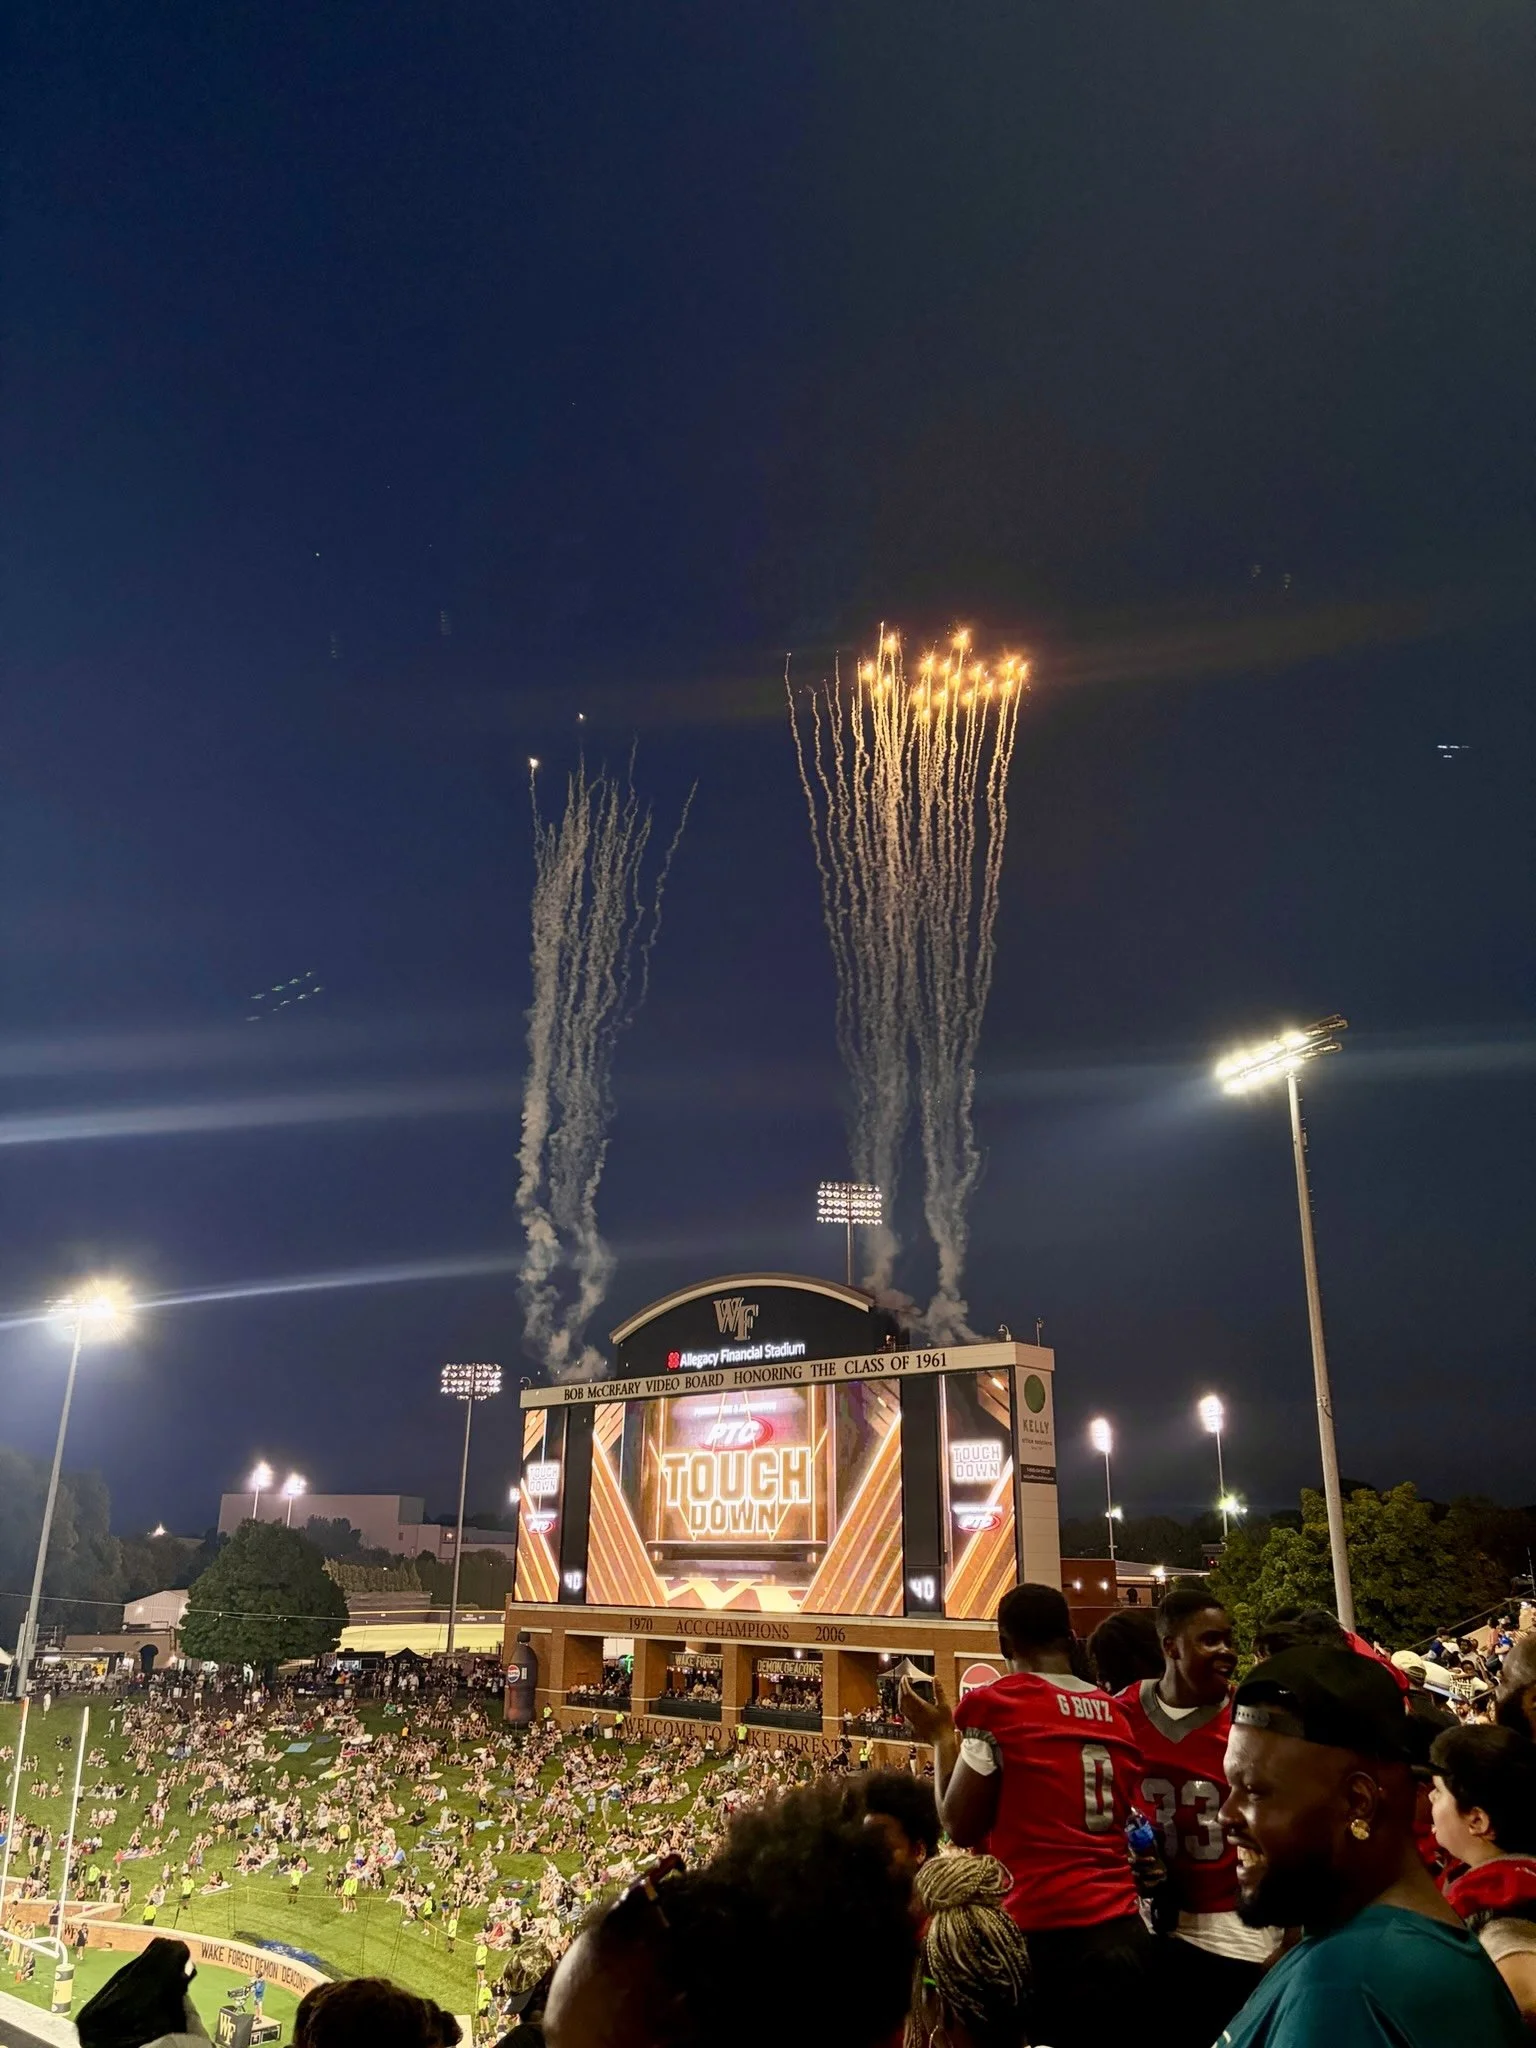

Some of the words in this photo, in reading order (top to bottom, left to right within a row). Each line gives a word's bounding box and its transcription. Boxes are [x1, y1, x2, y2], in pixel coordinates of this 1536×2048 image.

[713, 1297, 759, 1341] WF
[680, 1351, 719, 1368] Allegacy
[720, 1347, 764, 1363] Financial
[765, 1342, 805, 1358] Stadium
[564, 1387, 584, 1401] BOB
[587, 1381, 642, 1398] McCREARY
[646, 1377, 680, 1392] VIDEO
[685, 1372, 724, 1389] BOARD
[734, 1365, 802, 1385] HONORING
[810, 1362, 837, 1378] THE
[844, 1358, 884, 1374] CLASS
[890, 1355, 910, 1370] OF
[916, 1352, 947, 1368] 1961
[1023, 1419, 1050, 1434] KELLY
[952, 1443, 1001, 1462] TOUCH
[661, 1446, 812, 1507] TOUCH
[955, 1462, 999, 1479] DOWN
[529, 1480, 557, 1493] DOWN
[689, 1500, 779, 1534] DOWN
[909, 1577, 936, 1602] 40
[628, 1617, 654, 1632] 1970
[675, 1619, 703, 1635] ACC
[705, 1620, 790, 1640] CHAMPIONS
[815, 1626, 846, 1642] 2006
[675, 1655, 694, 1666] WAKE
[696, 1656, 723, 1669] FOREST
[757, 1660, 783, 1673] DEMON
[784, 1663, 821, 1676] DEACONS
[1056, 1694, 1070, 1716] G
[1070, 1695, 1113, 1723] BOYZ
[624, 1717, 696, 1739] WELCOME
[702, 1725, 722, 1742] TO
[778, 1733, 841, 1757] FOREST
[1082, 1743, 1114, 1831] 0
[1141, 1777, 1224, 1861] 33
[201, 1941, 225, 1962] WAKE
[227, 1947, 254, 1971] FOREST
[255, 1957, 279, 1979] DEMON
